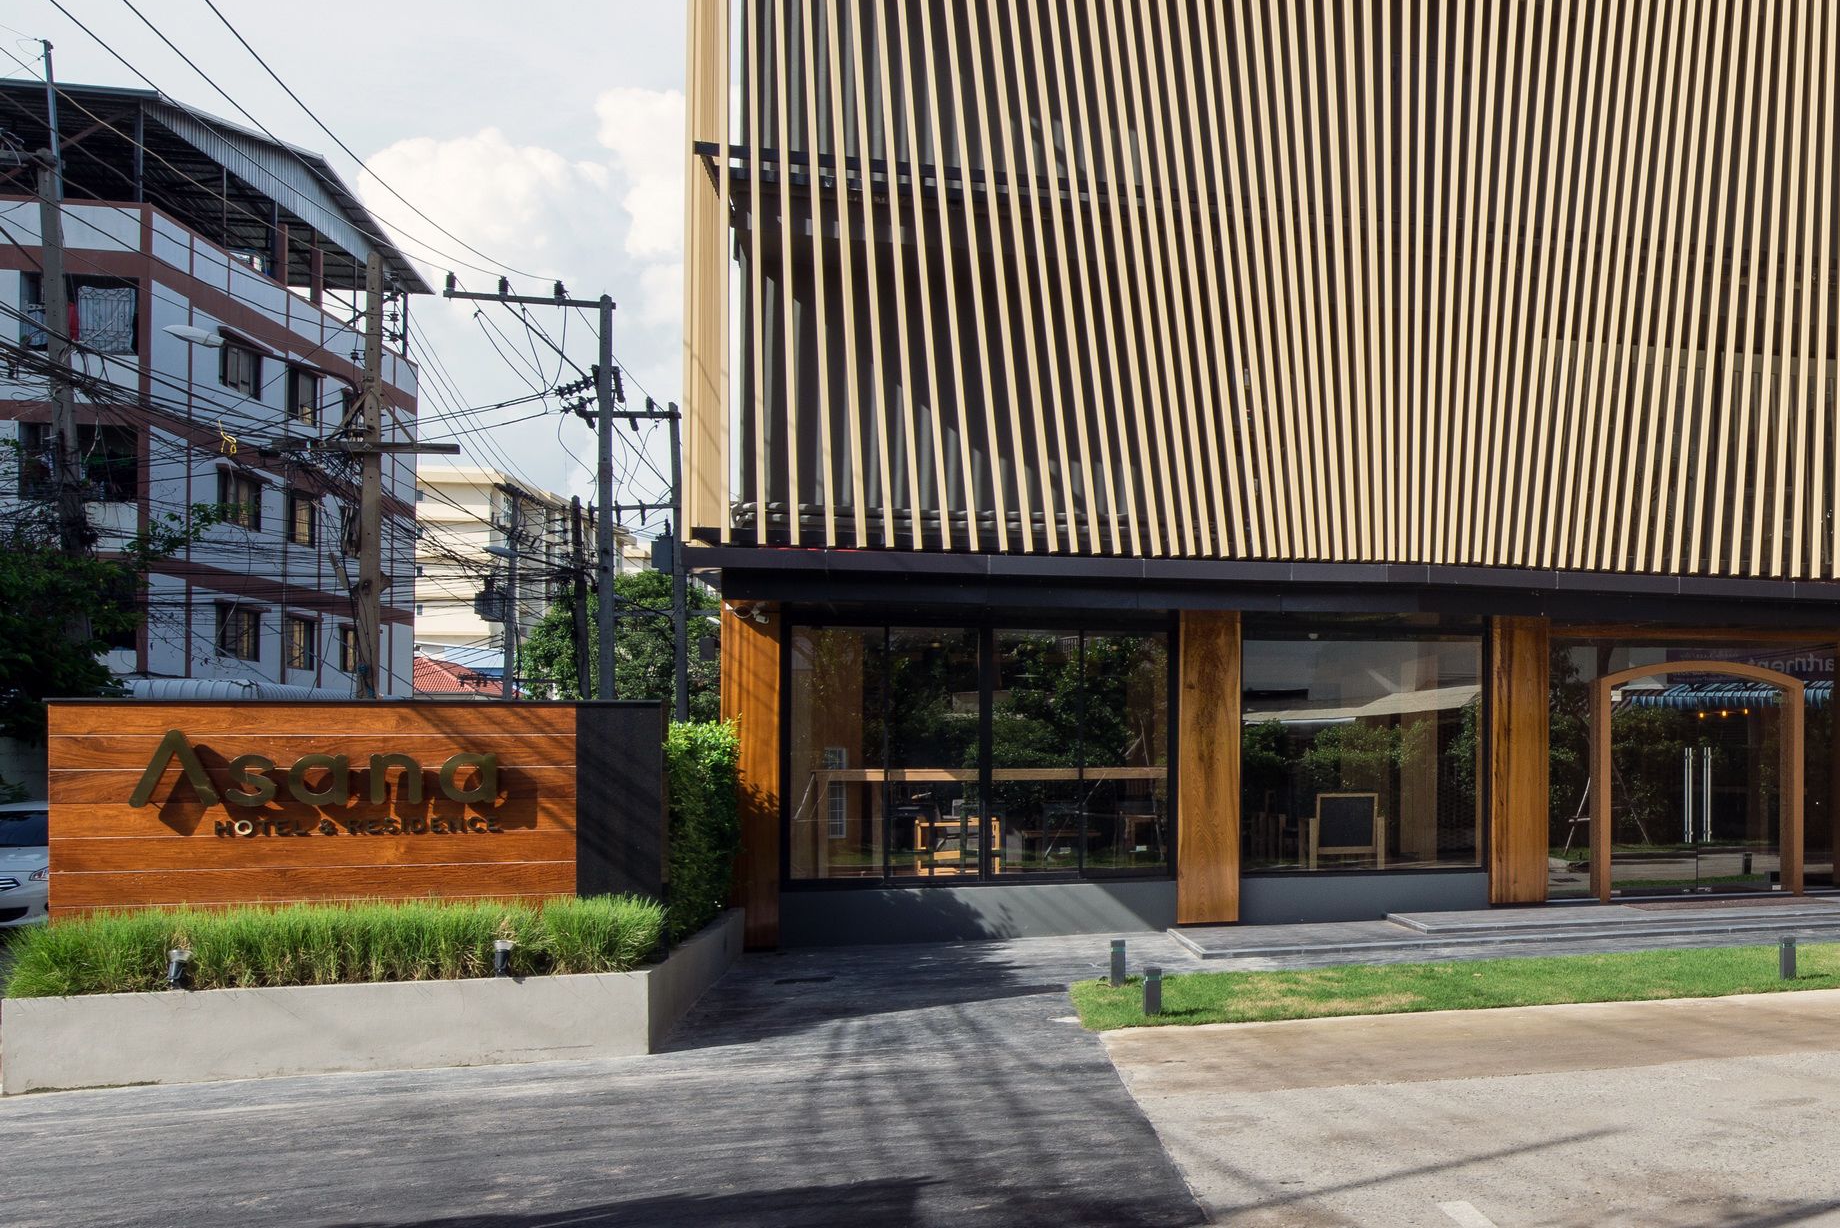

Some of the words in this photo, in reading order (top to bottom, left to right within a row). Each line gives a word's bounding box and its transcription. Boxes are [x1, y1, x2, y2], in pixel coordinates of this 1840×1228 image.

[129, 729, 499, 808] Asana
[214, 819, 308, 837] HOTEL
[319, 819, 337, 836] &
[346, 816, 502, 835] RESIDENCE
